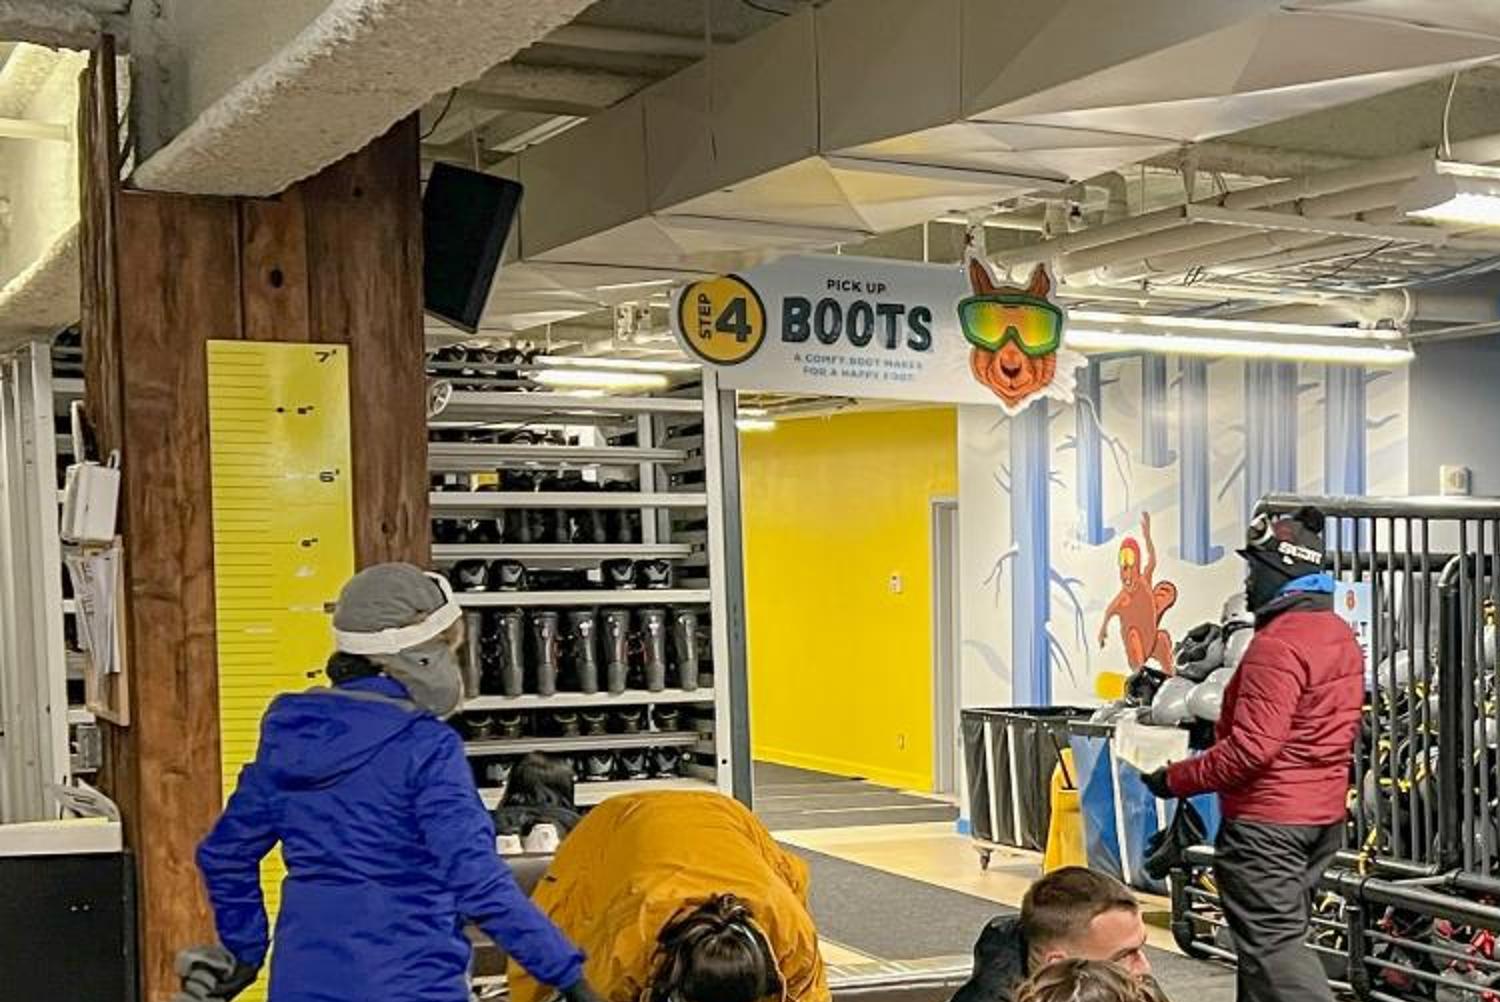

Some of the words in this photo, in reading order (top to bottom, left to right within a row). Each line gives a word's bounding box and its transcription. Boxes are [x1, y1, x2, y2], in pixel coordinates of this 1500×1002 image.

[826, 279, 861, 293] PICK
[866, 283, 887, 294] UP
[697, 293, 712, 340] STEP
[715, 297, 752, 342] 4
[781, 296, 932, 352] BOOTS
